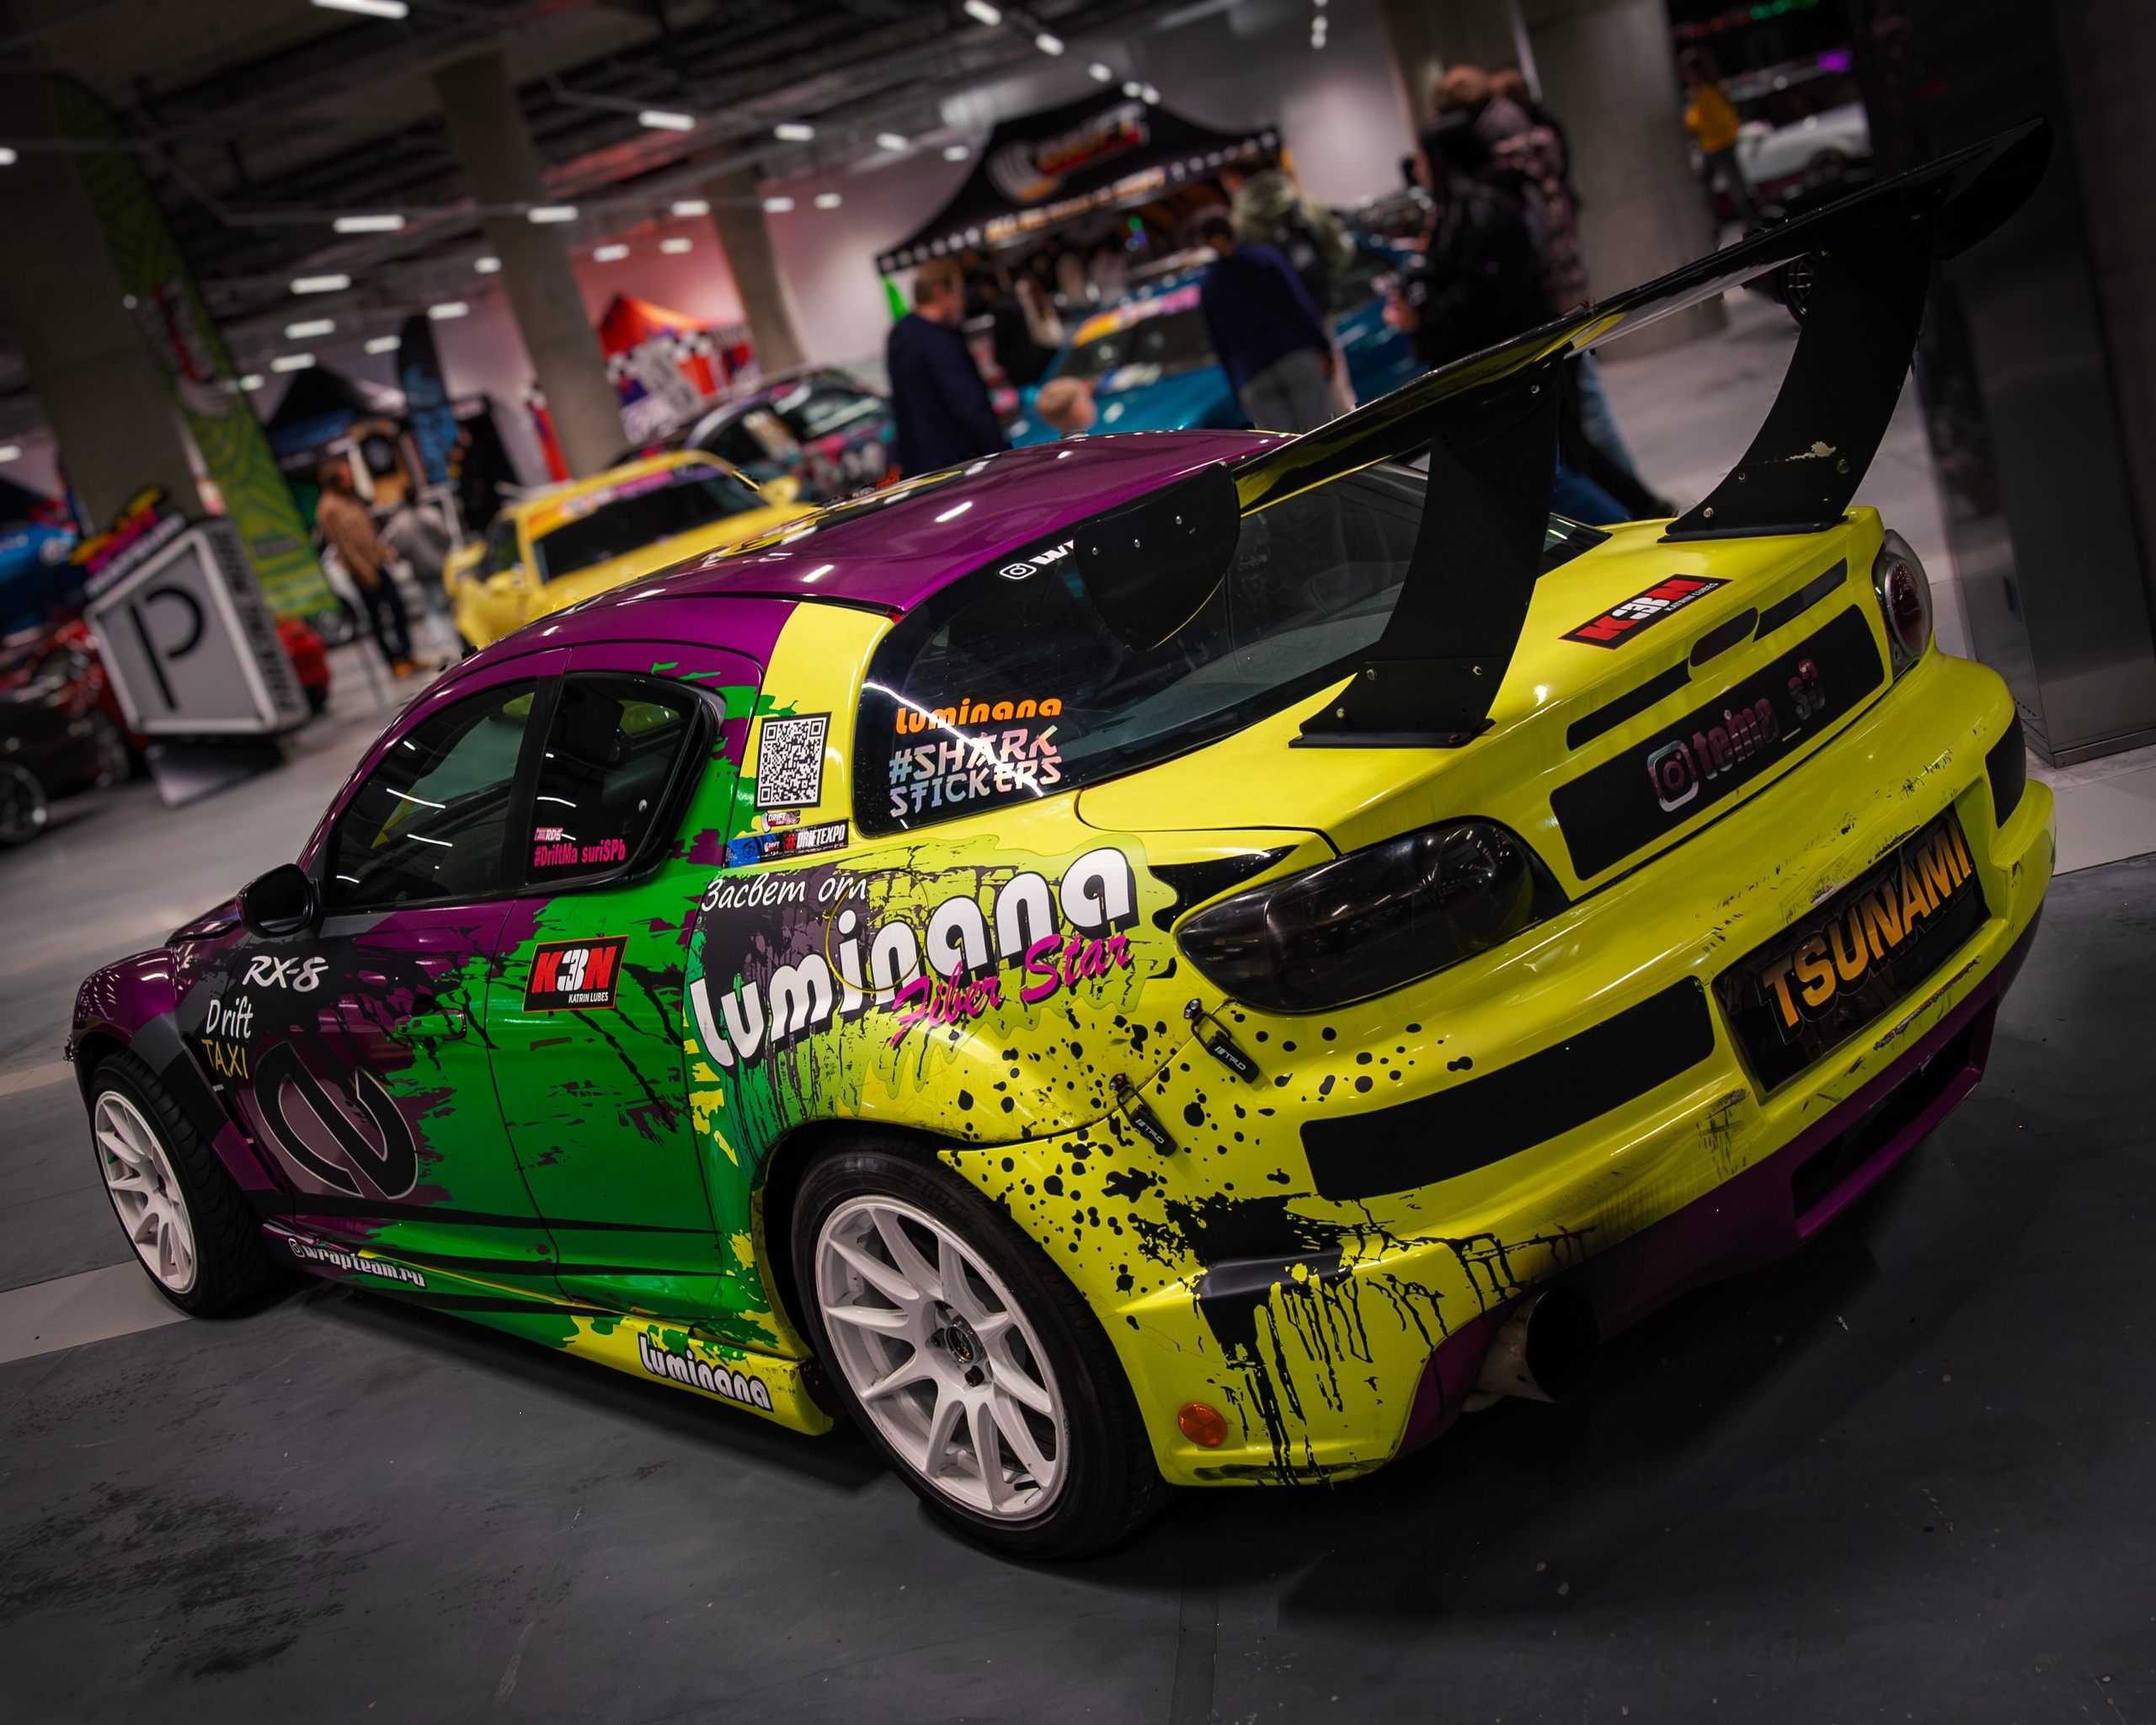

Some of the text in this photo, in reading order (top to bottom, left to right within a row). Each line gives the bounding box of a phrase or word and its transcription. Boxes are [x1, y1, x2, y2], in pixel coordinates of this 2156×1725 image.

[1663, 594, 1696, 612] KATRIN
[889, 724, 1059, 785] #SHARK
[889, 756, 1063, 818] STICKERS
[785, 824, 846, 851] #DRIFTEXPO
[702, 872, 806, 913] Засвет
[1761, 817, 1972, 1028] TSUNAMI
[243, 955, 329, 992] RX-8
[890, 929, 1135, 1048] Fiber Star
[568, 992, 609, 1003] KATRIN LUBES
[201, 1039, 248, 1080] TAXI
[301, 1244, 426, 1288] wrapteam.ru
